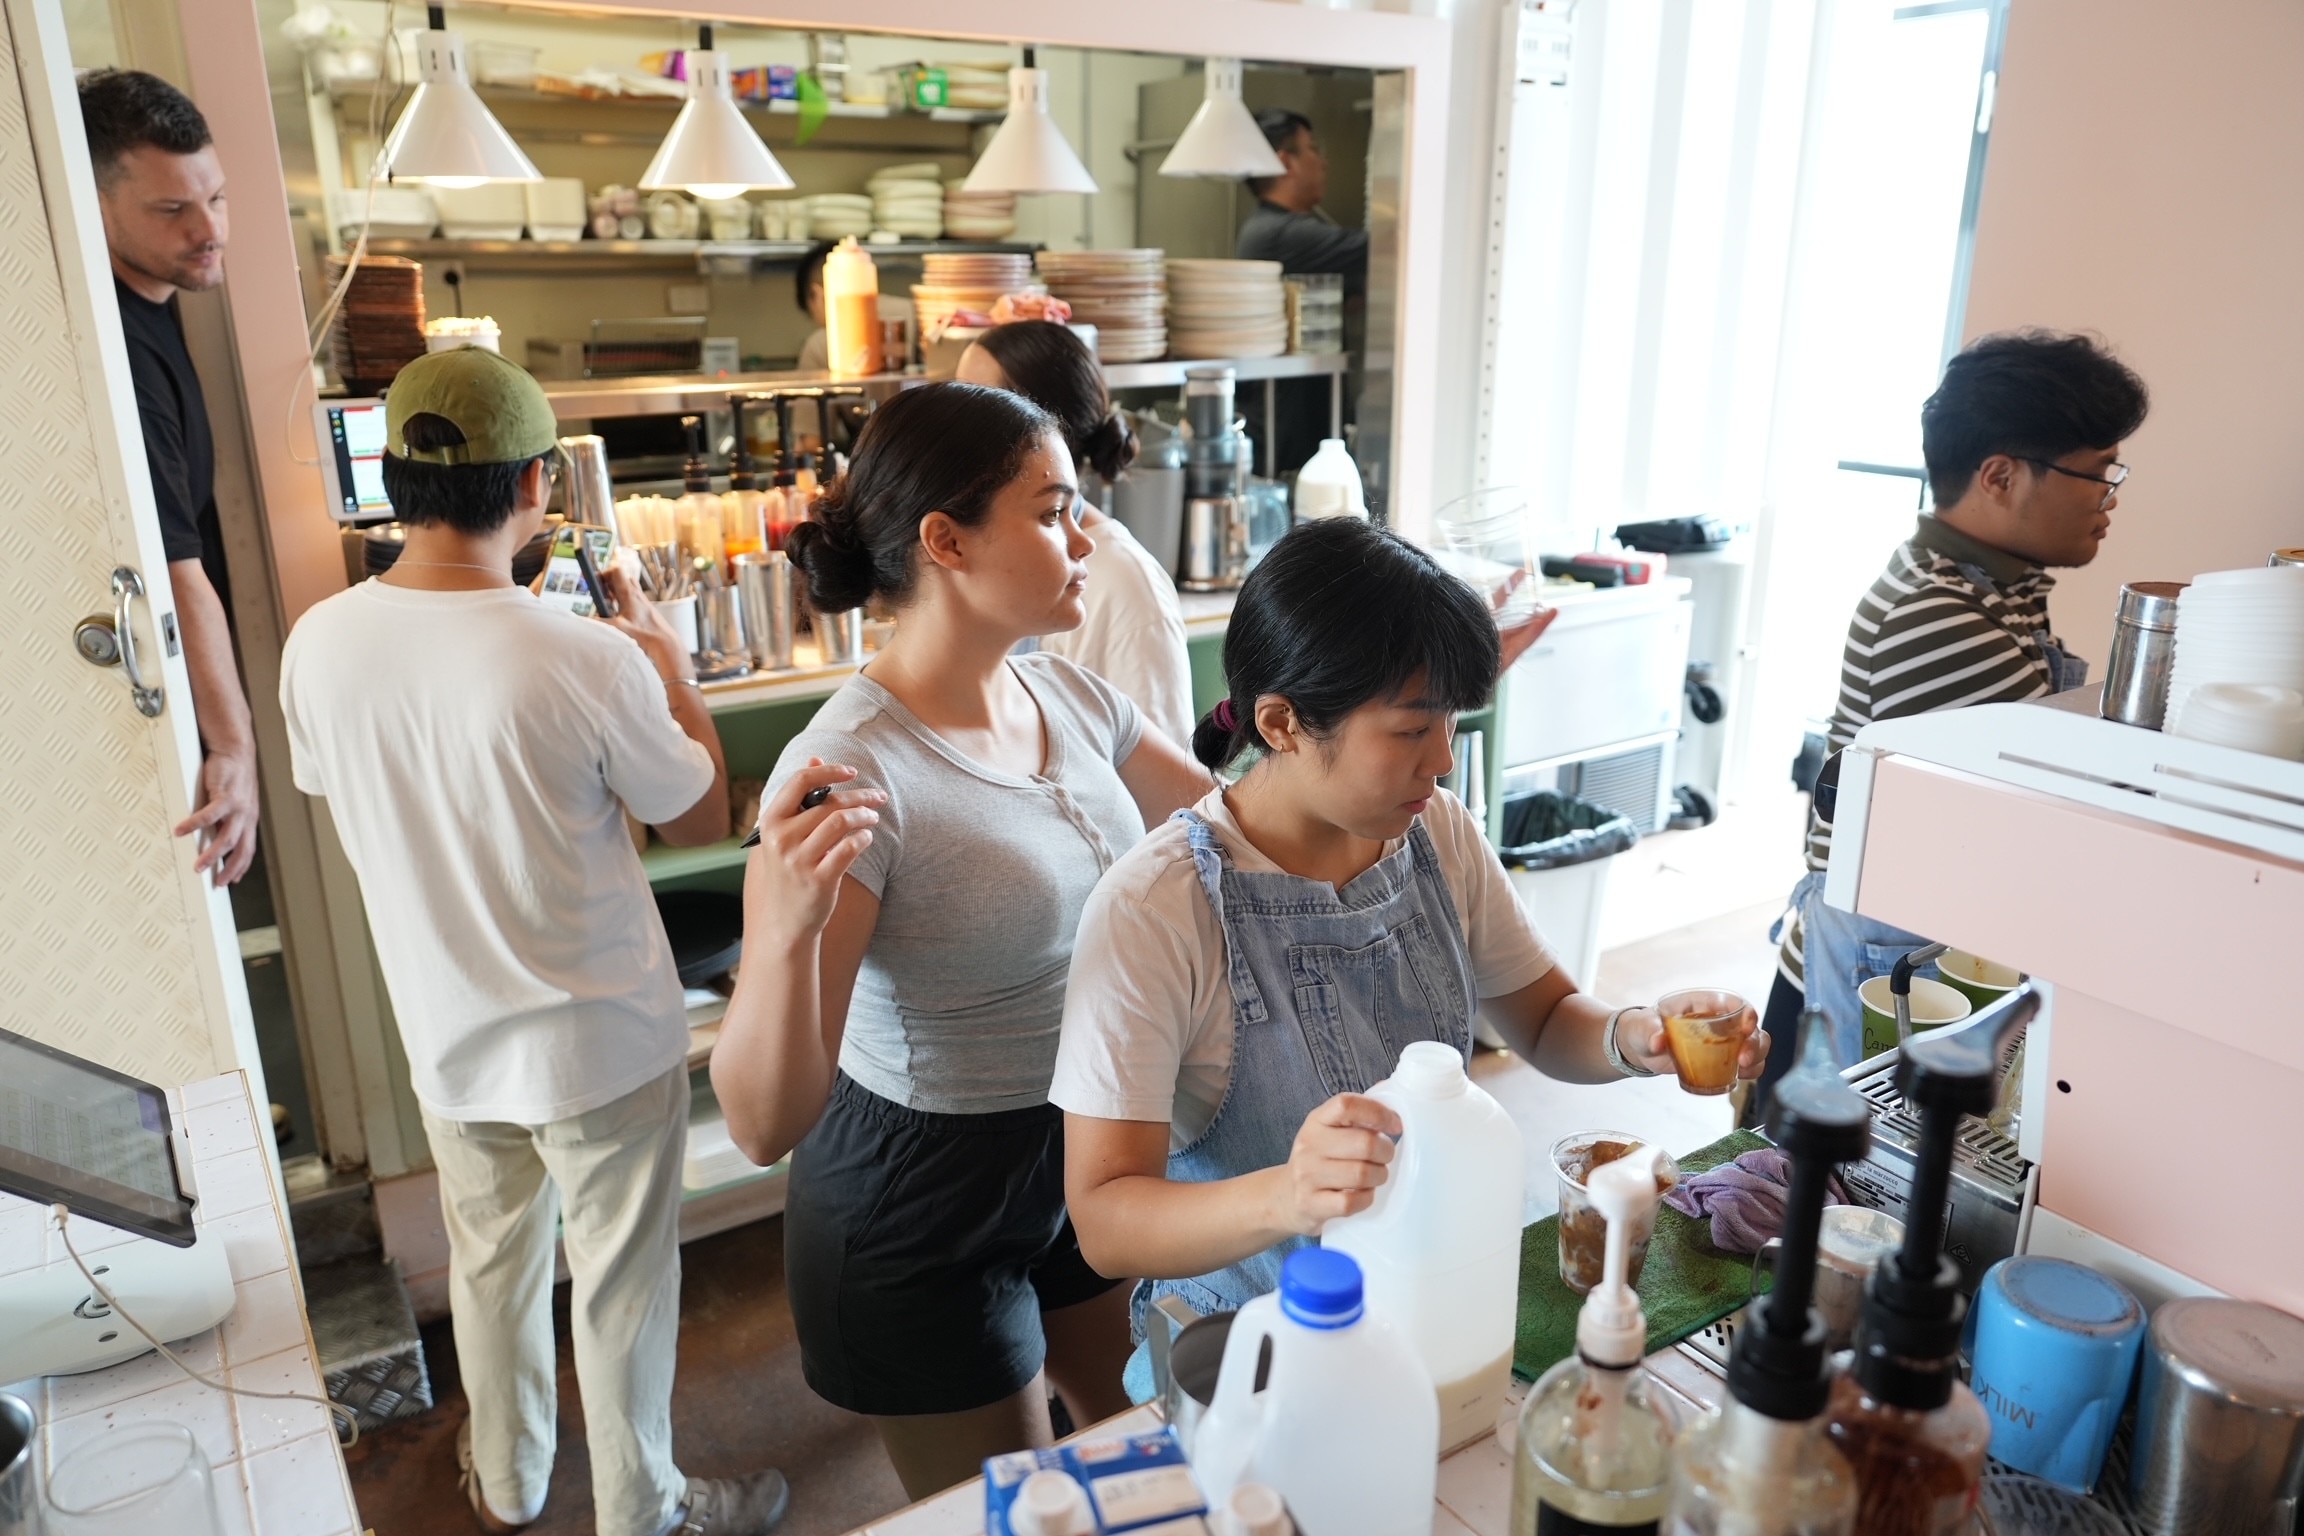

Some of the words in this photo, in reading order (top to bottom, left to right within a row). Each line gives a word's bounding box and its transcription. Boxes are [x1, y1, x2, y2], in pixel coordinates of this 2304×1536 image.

[1864, 1027, 1896, 1052] Cam
[1867, 1165, 1873, 1173] la
[1873, 1170, 1899, 1186] marzocco
[1976, 1374, 2035, 1430] MILK
